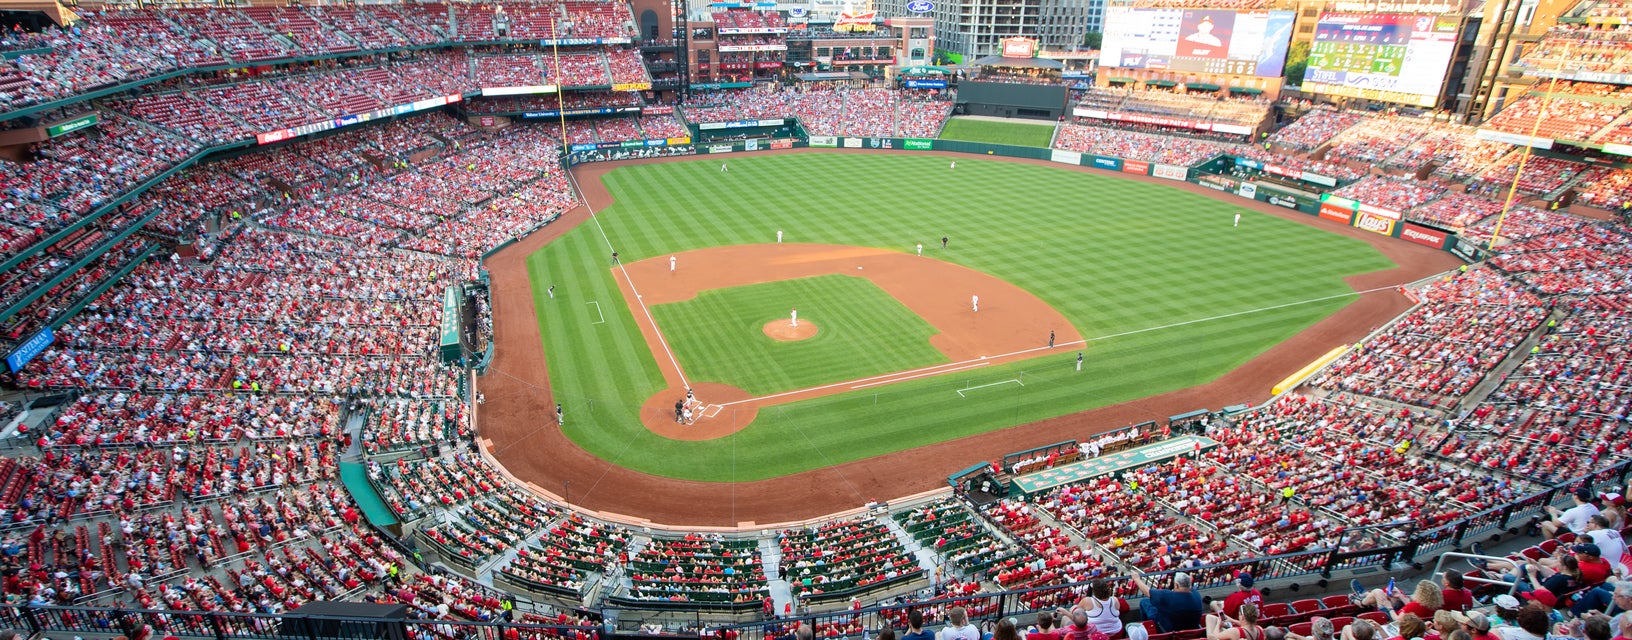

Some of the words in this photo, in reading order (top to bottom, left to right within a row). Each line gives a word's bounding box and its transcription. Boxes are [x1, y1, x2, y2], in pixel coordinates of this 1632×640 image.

[912, 2, 930, 11] Ford
[1336, 2, 1375, 12] WORLD
[1376, 3, 1451, 13] CHAMPIONS
[837, 14, 873, 24] Budweiser
[1236, 65, 1243, 73] 0
[1246, 66, 1254, 74] 2
[1313, 69, 1337, 80] STIFEL
[1373, 77, 1398, 88] SSM
[1129, 115, 1168, 125] SCOREBOARD
[1403, 228, 1442, 244] EQUIFAX
[21, 330, 47, 354] SITEMAN
